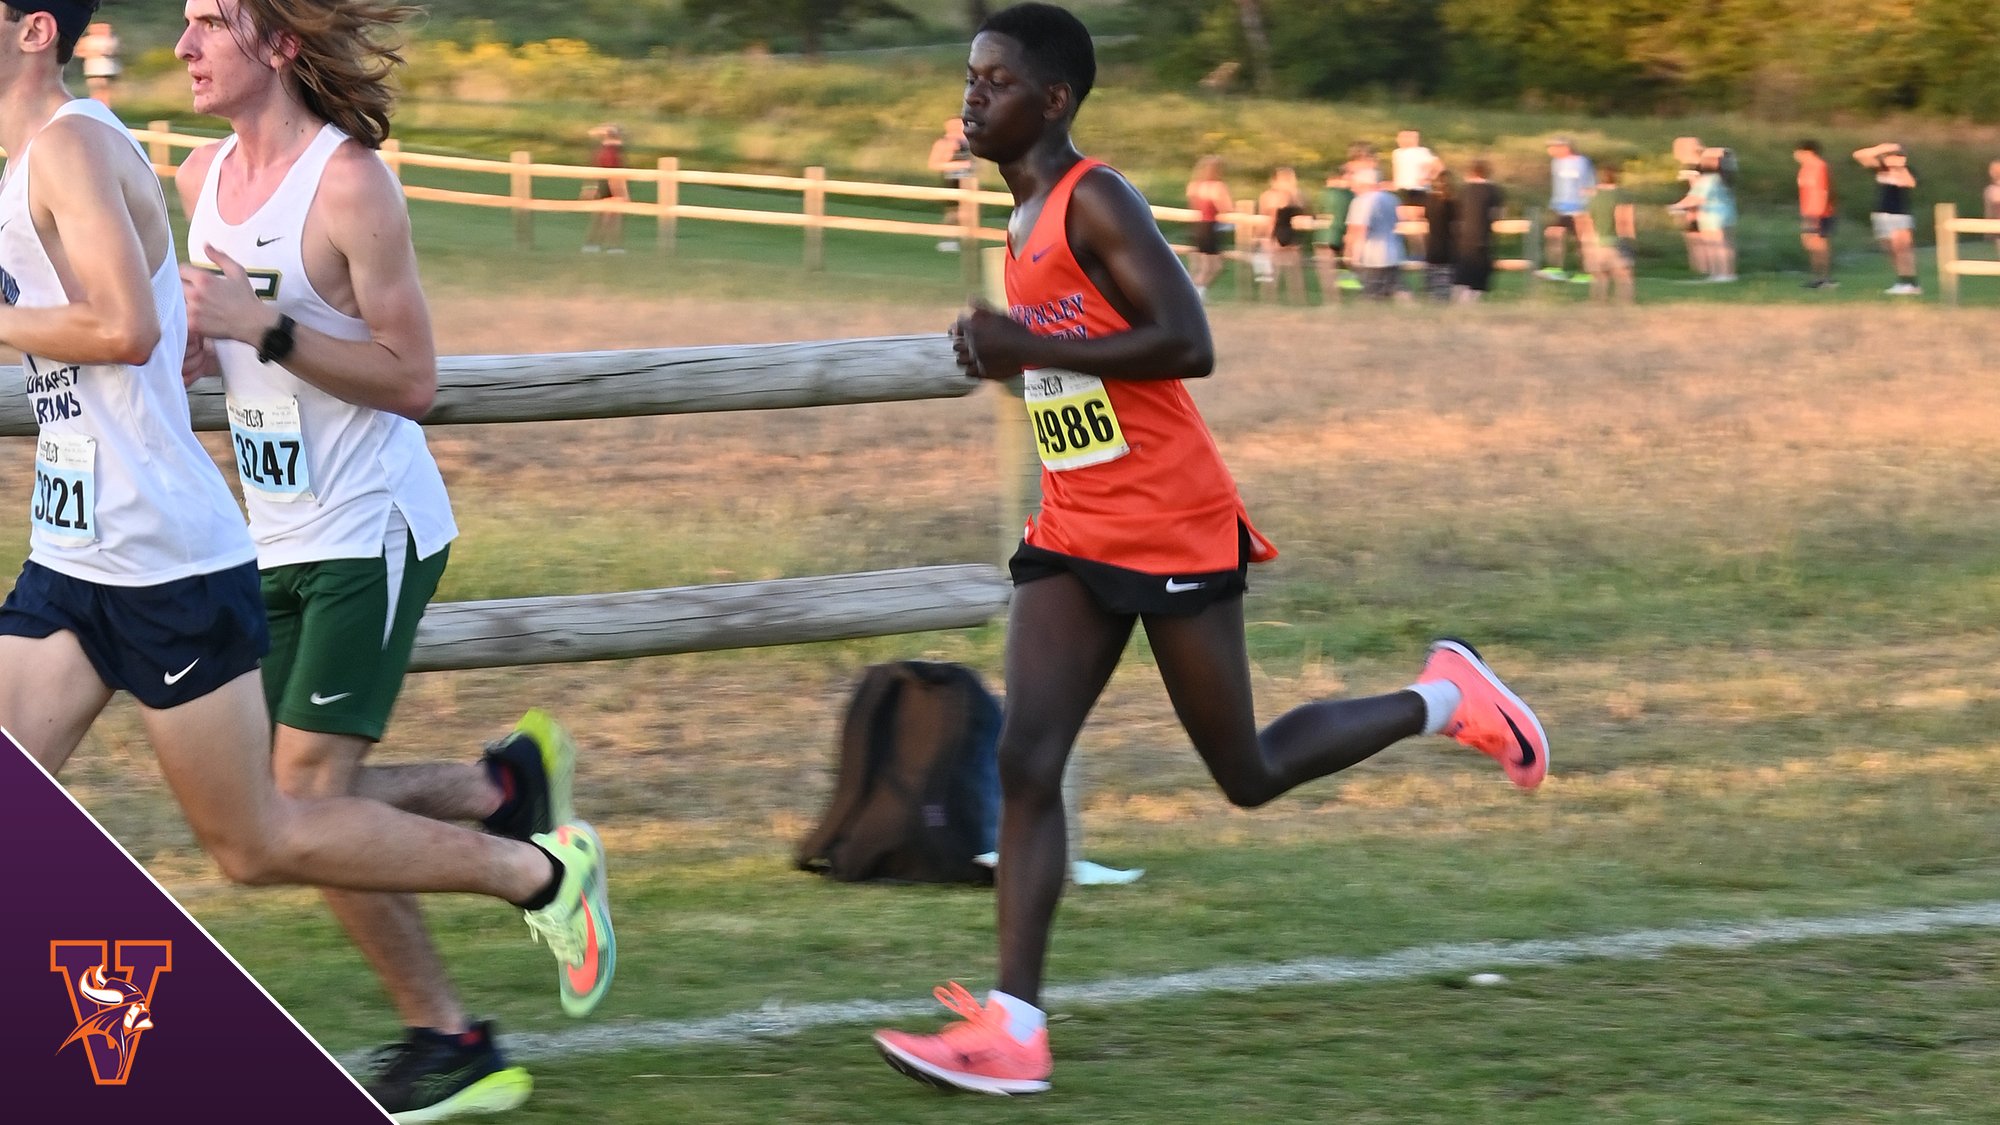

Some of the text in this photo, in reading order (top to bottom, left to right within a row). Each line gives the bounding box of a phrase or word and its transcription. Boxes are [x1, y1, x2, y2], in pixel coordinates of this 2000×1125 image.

[1034, 399, 1115, 454] 4986
[235, 433, 300, 486] 3247
[35, 469, 88, 530] 3221
